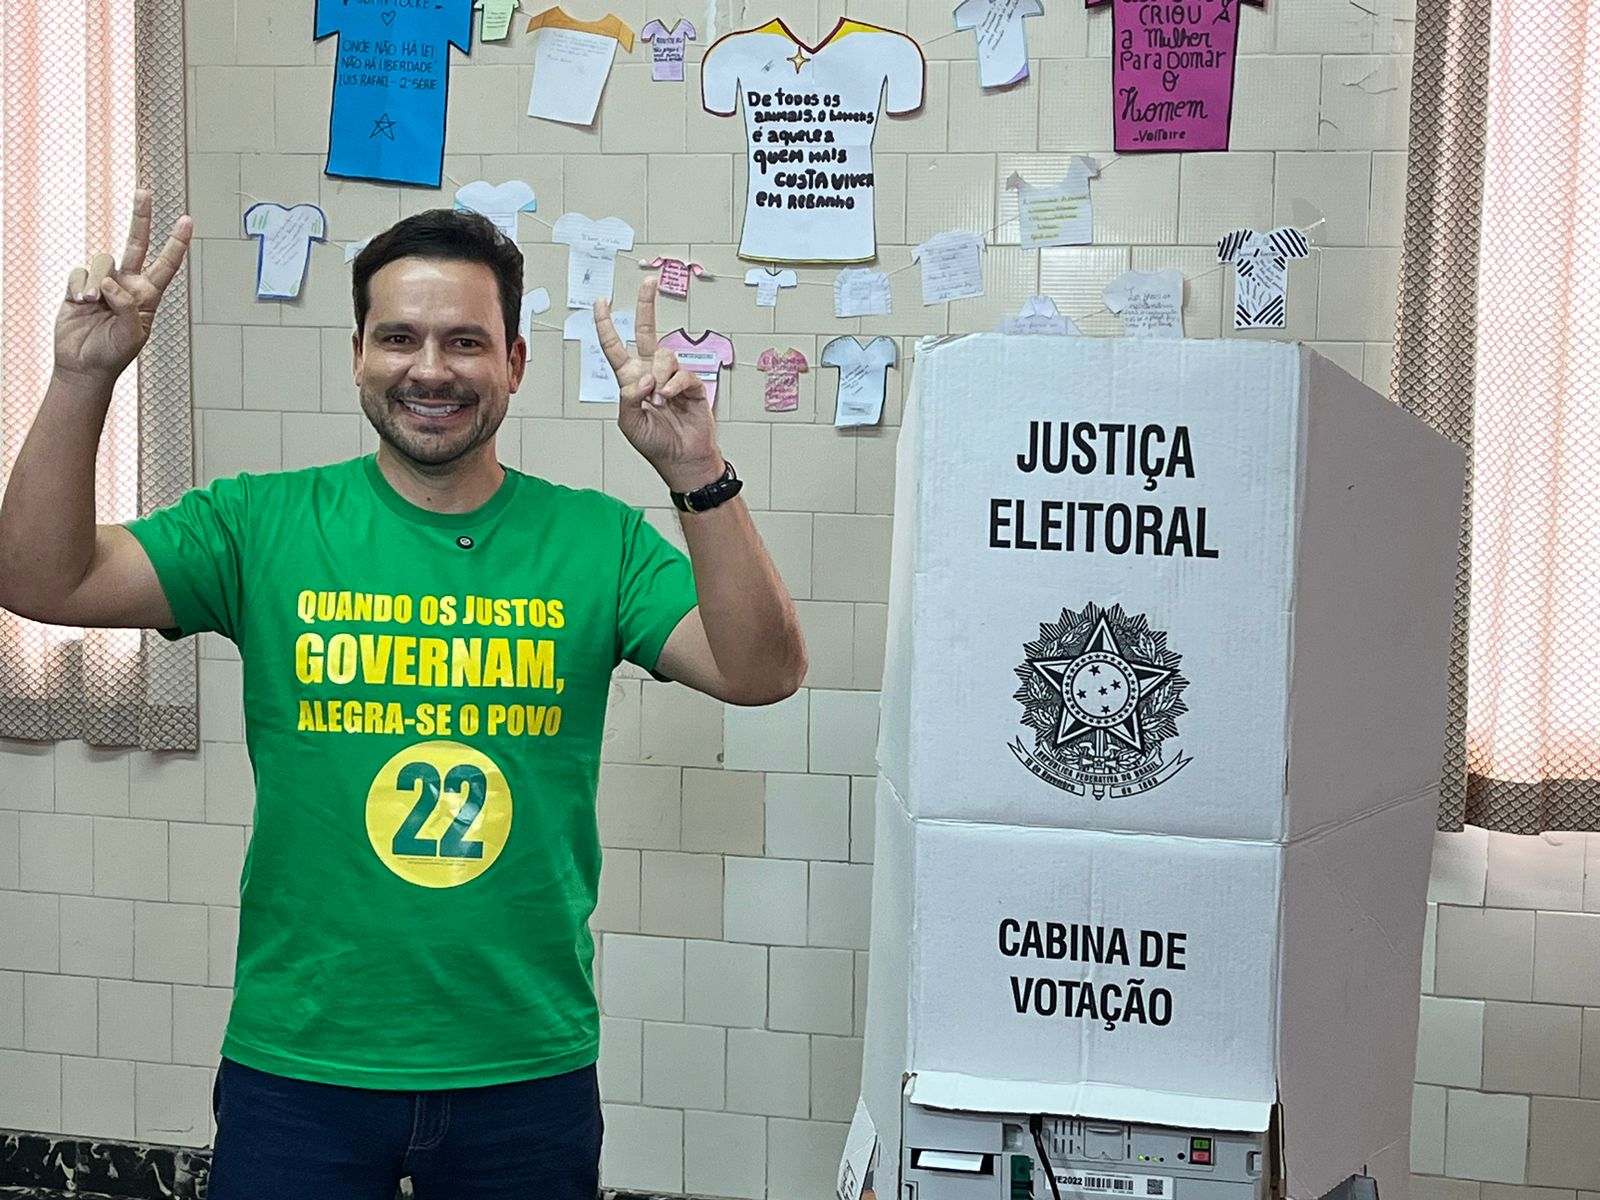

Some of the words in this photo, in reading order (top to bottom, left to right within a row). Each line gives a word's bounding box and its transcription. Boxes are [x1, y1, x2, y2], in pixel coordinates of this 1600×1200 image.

[1139, 4, 1202, 25] CRIOU
[375, 40, 397, 55] NÃO
[1121, 29, 1133, 49] a
[1144, 27, 1212, 48] Mulher
[341, 55, 361, 69] NÃO
[1120, 51, 1162, 70] Para
[1167, 50, 1226, 69] Domar
[747, 91, 772, 107] De
[1119, 86, 1208, 122] Homem
[752, 126, 763, 142] é
[774, 168, 828, 189] CUSTA
[1016, 421, 1195, 491] JUSTIÇA
[989, 498, 1219, 558] ELEITORAL
[297, 590, 412, 624] QUANDO
[420, 595, 457, 626] OS
[462, 595, 565, 628] JUSTOS
[295, 632, 565, 694] GOVERNAM,
[297, 700, 452, 736] ALEGRA-SE
[460, 704, 479, 736] O
[487, 704, 562, 736] POVO
[391, 761, 488, 859] 22
[999, 918, 1130, 966] CABINA
[1139, 930, 1187, 970] DE
[1010, 976, 1173, 1031] VOTAÇÃO
